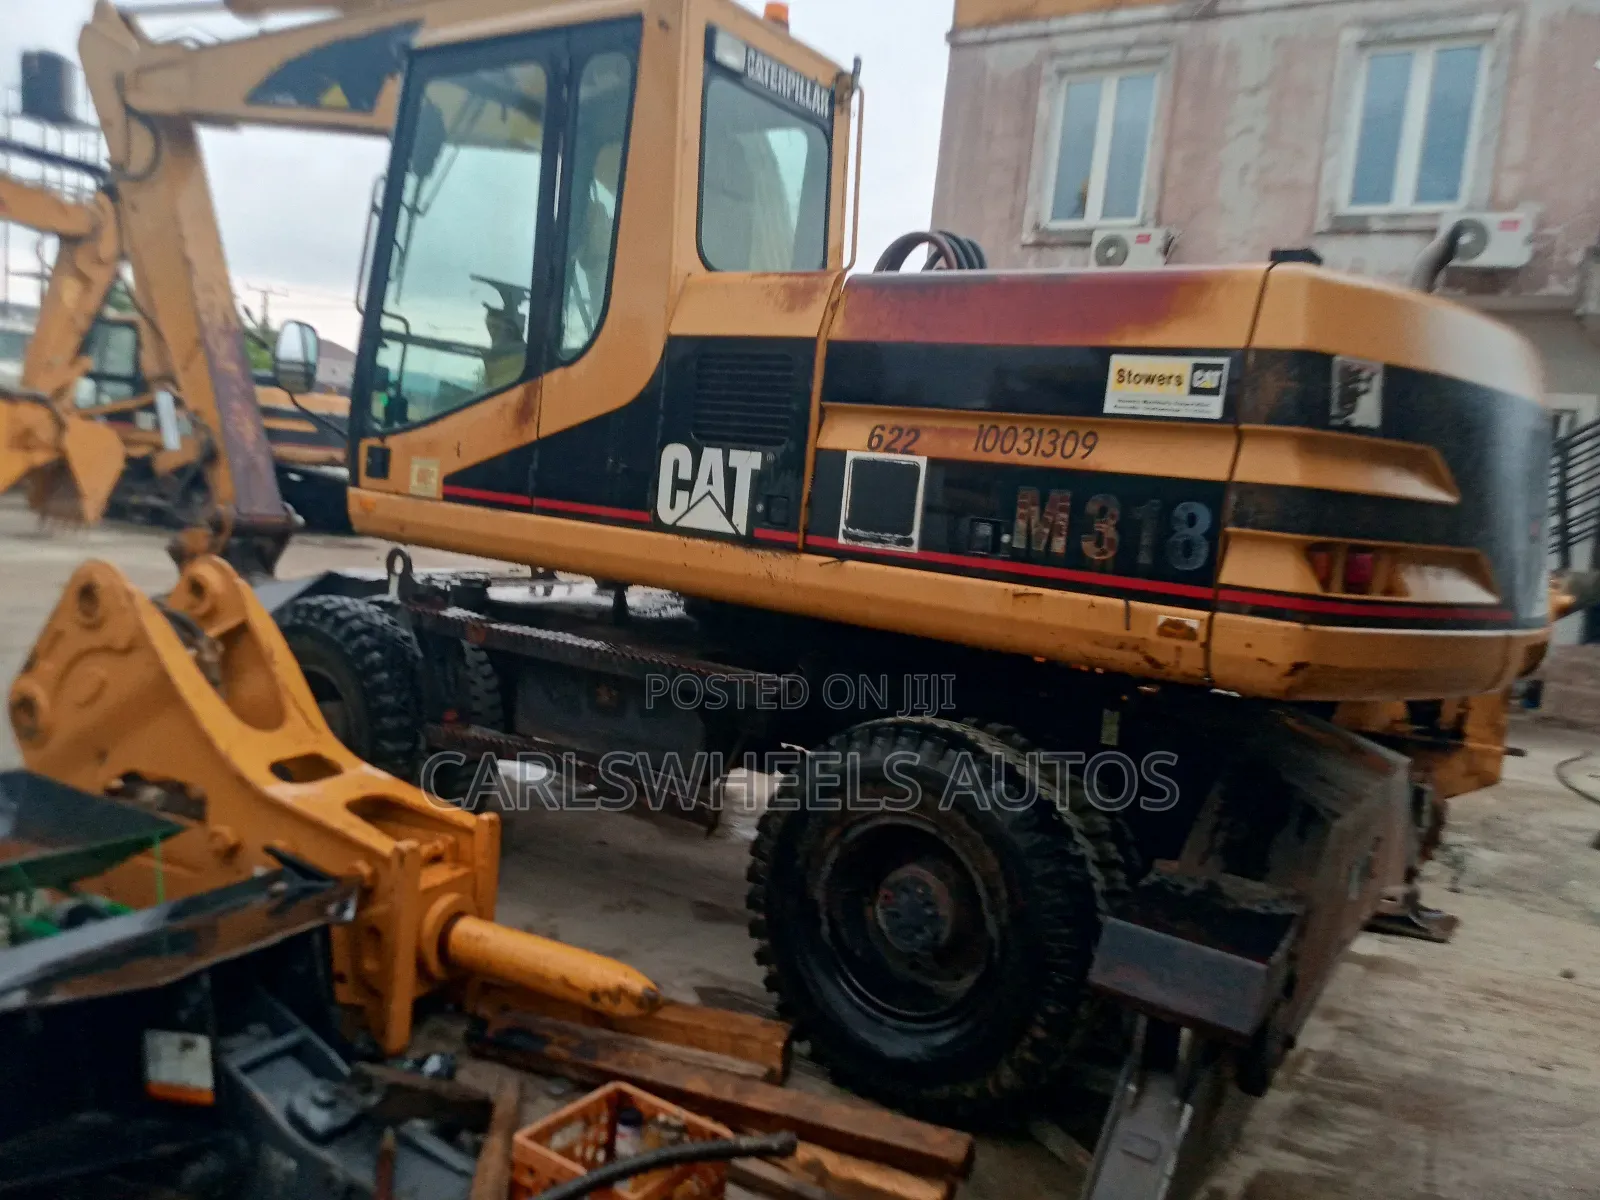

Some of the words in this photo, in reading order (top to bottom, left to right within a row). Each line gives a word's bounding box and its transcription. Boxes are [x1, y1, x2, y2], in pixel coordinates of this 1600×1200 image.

[746, 47, 831, 120] CATERPILLAR
[1116, 368, 1184, 387] Stowers
[867, 423, 921, 456] 622
[973, 423, 1099, 460] 10031309
[656, 442, 762, 536] CAT
[1011, 486, 1213, 571] M318
